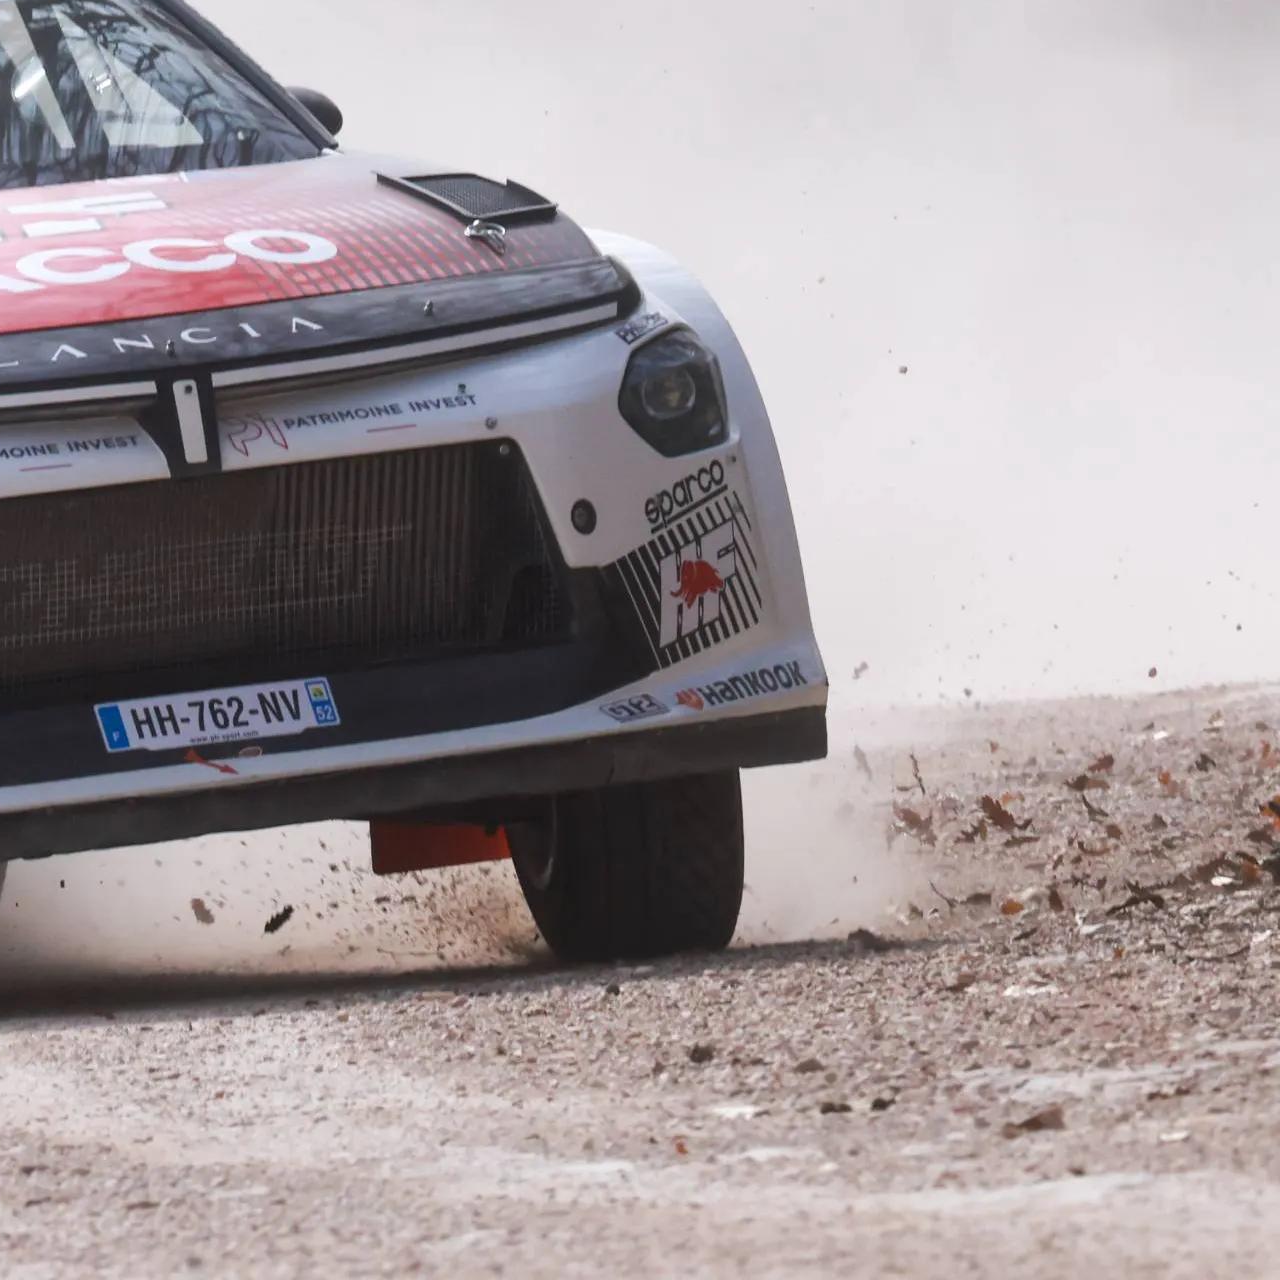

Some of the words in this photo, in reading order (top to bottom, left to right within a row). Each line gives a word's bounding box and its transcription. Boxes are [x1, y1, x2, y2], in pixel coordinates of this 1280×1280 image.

[283, 403, 403, 430] PATRIMOINE
[408, 394, 477, 413] INVEST
[67, 435, 138, 453] INVEST
[644, 459, 725, 526] sparco
[130, 688, 302, 739] HH-762-NV
[317, 704, 335, 722] 52
[110, 731, 121, 743] F
